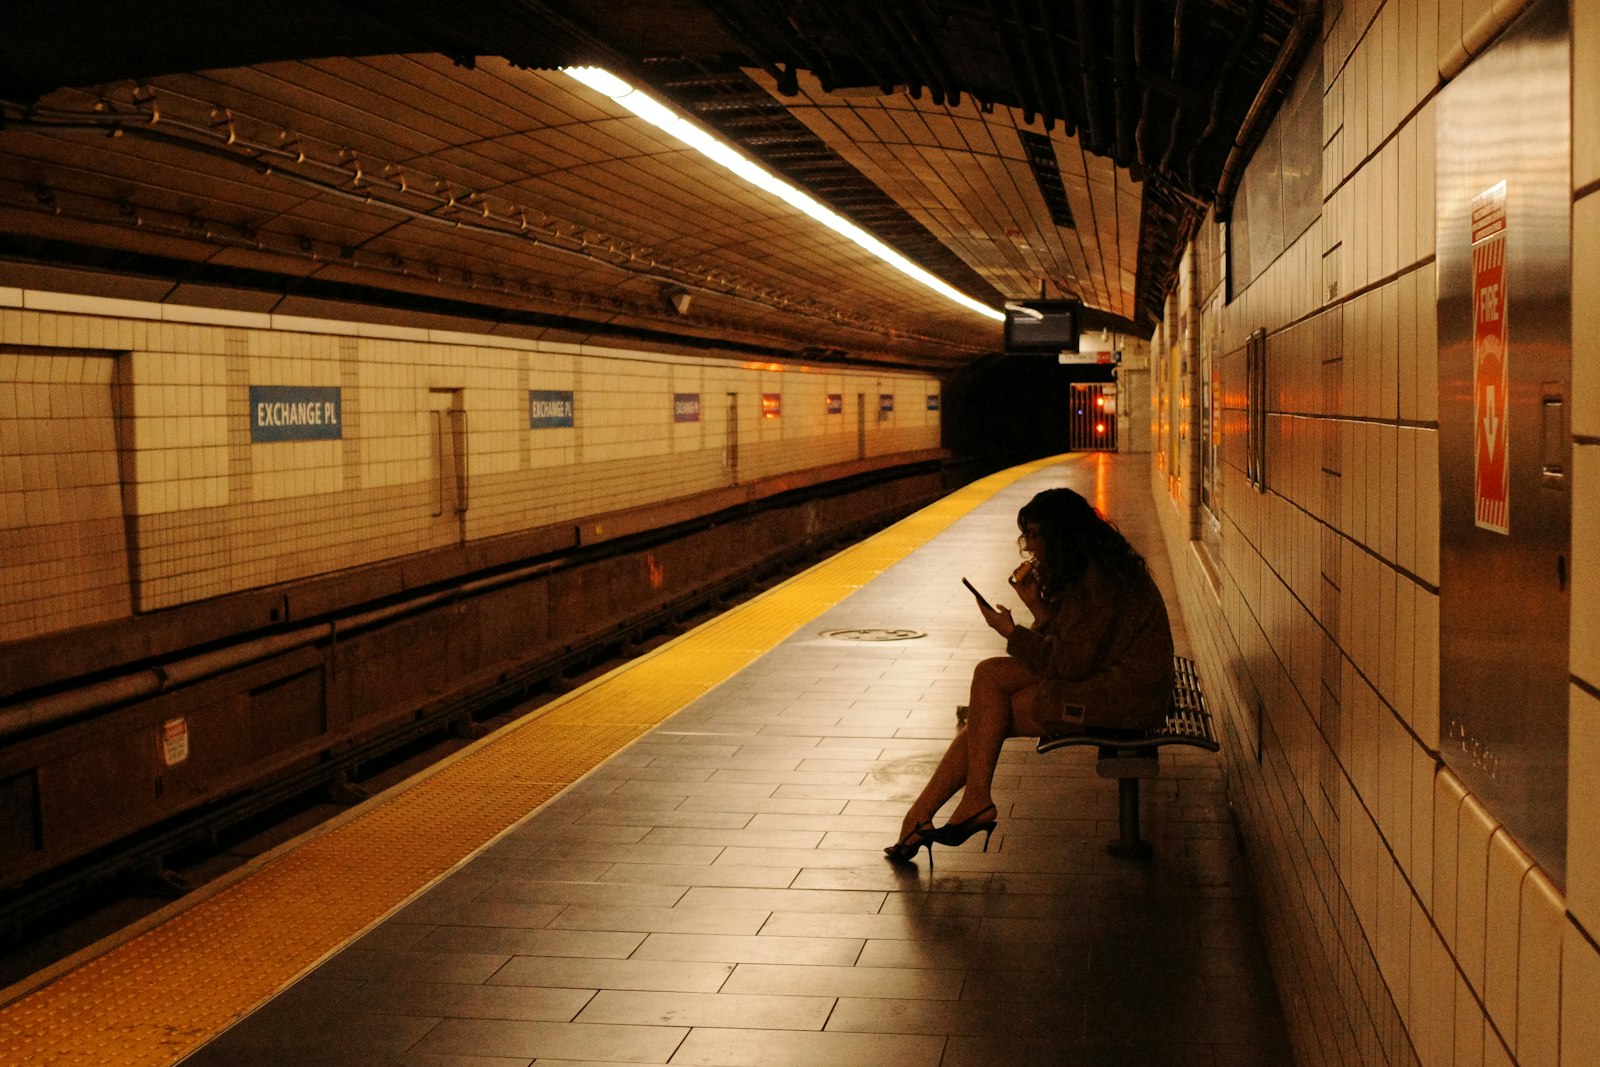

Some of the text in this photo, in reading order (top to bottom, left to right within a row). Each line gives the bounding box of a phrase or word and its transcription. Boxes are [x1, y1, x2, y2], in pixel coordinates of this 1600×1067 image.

[1480, 283, 1499, 323] FIRE
[257, 402, 337, 426] EXCHANGE PL
